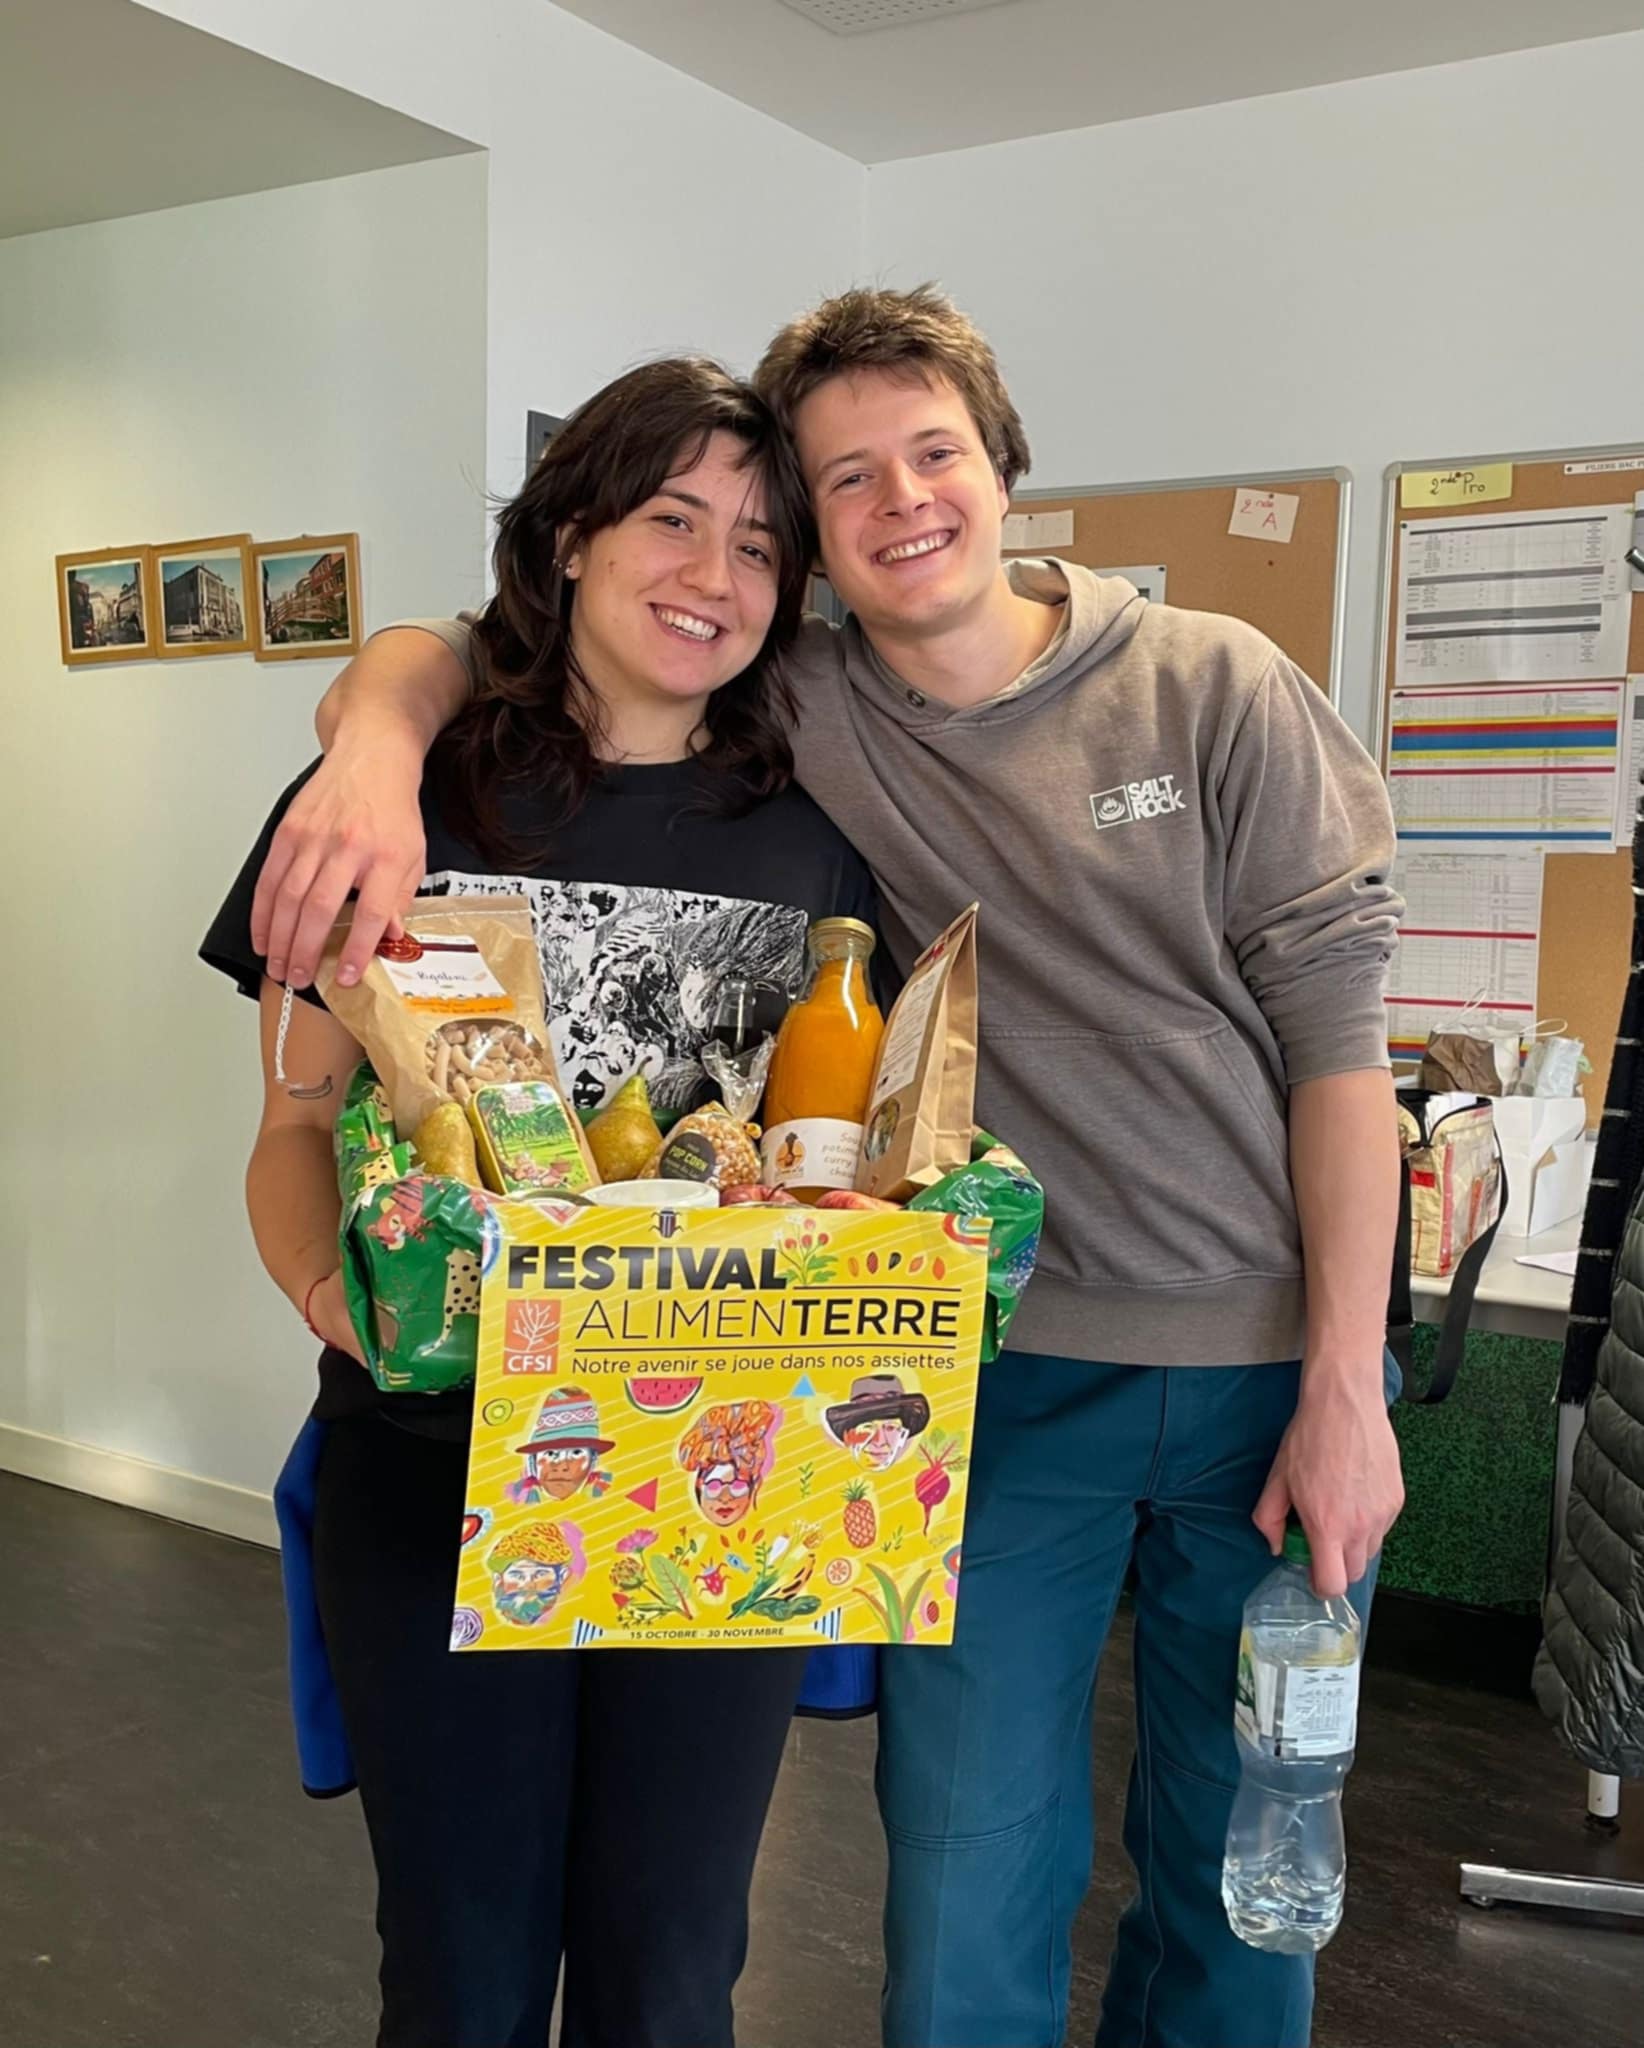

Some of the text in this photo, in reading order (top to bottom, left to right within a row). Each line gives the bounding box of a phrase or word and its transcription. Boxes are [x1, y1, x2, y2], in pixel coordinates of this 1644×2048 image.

[1463, 471, 1486, 496] Pro
[1262, 511, 1278, 531] A
[1127, 774, 1174, 802] SALT
[1131, 789, 1187, 820] ROCK
[668, 1145, 687, 1159] POP
[507, 1244, 788, 1291] FESTIVAL
[575, 1297, 961, 1340] ALIMENTERRE
[507, 1354, 553, 1373] CFSI
[572, 1352, 956, 1374] Notre avenir se joue dans nos assiettes
[630, 1631, 642, 1640] 15
[645, 1629, 698, 1639] OCTOBRE
[707, 1629, 721, 1638] 30
[723, 1627, 785, 1638] NOVEMBRE
